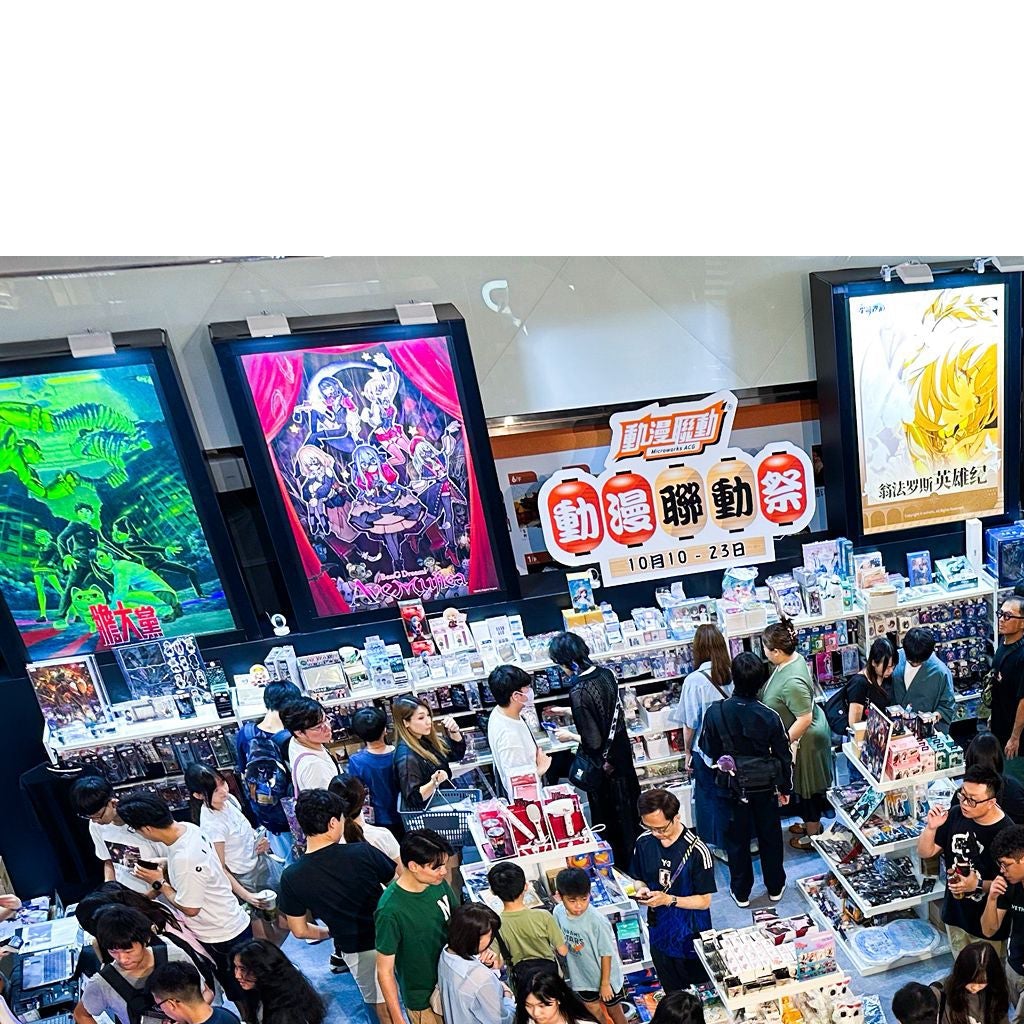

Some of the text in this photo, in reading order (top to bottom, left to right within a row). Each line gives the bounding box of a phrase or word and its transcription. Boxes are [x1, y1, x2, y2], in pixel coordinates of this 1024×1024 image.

[620, 408, 719, 453] 動漫聯動
[651, 443, 696, 454] Microworks ACG
[553, 467, 803, 543] 動漫聯動祭
[628, 551, 688, 572] 10月10
[709, 541, 746, 560] 23日
